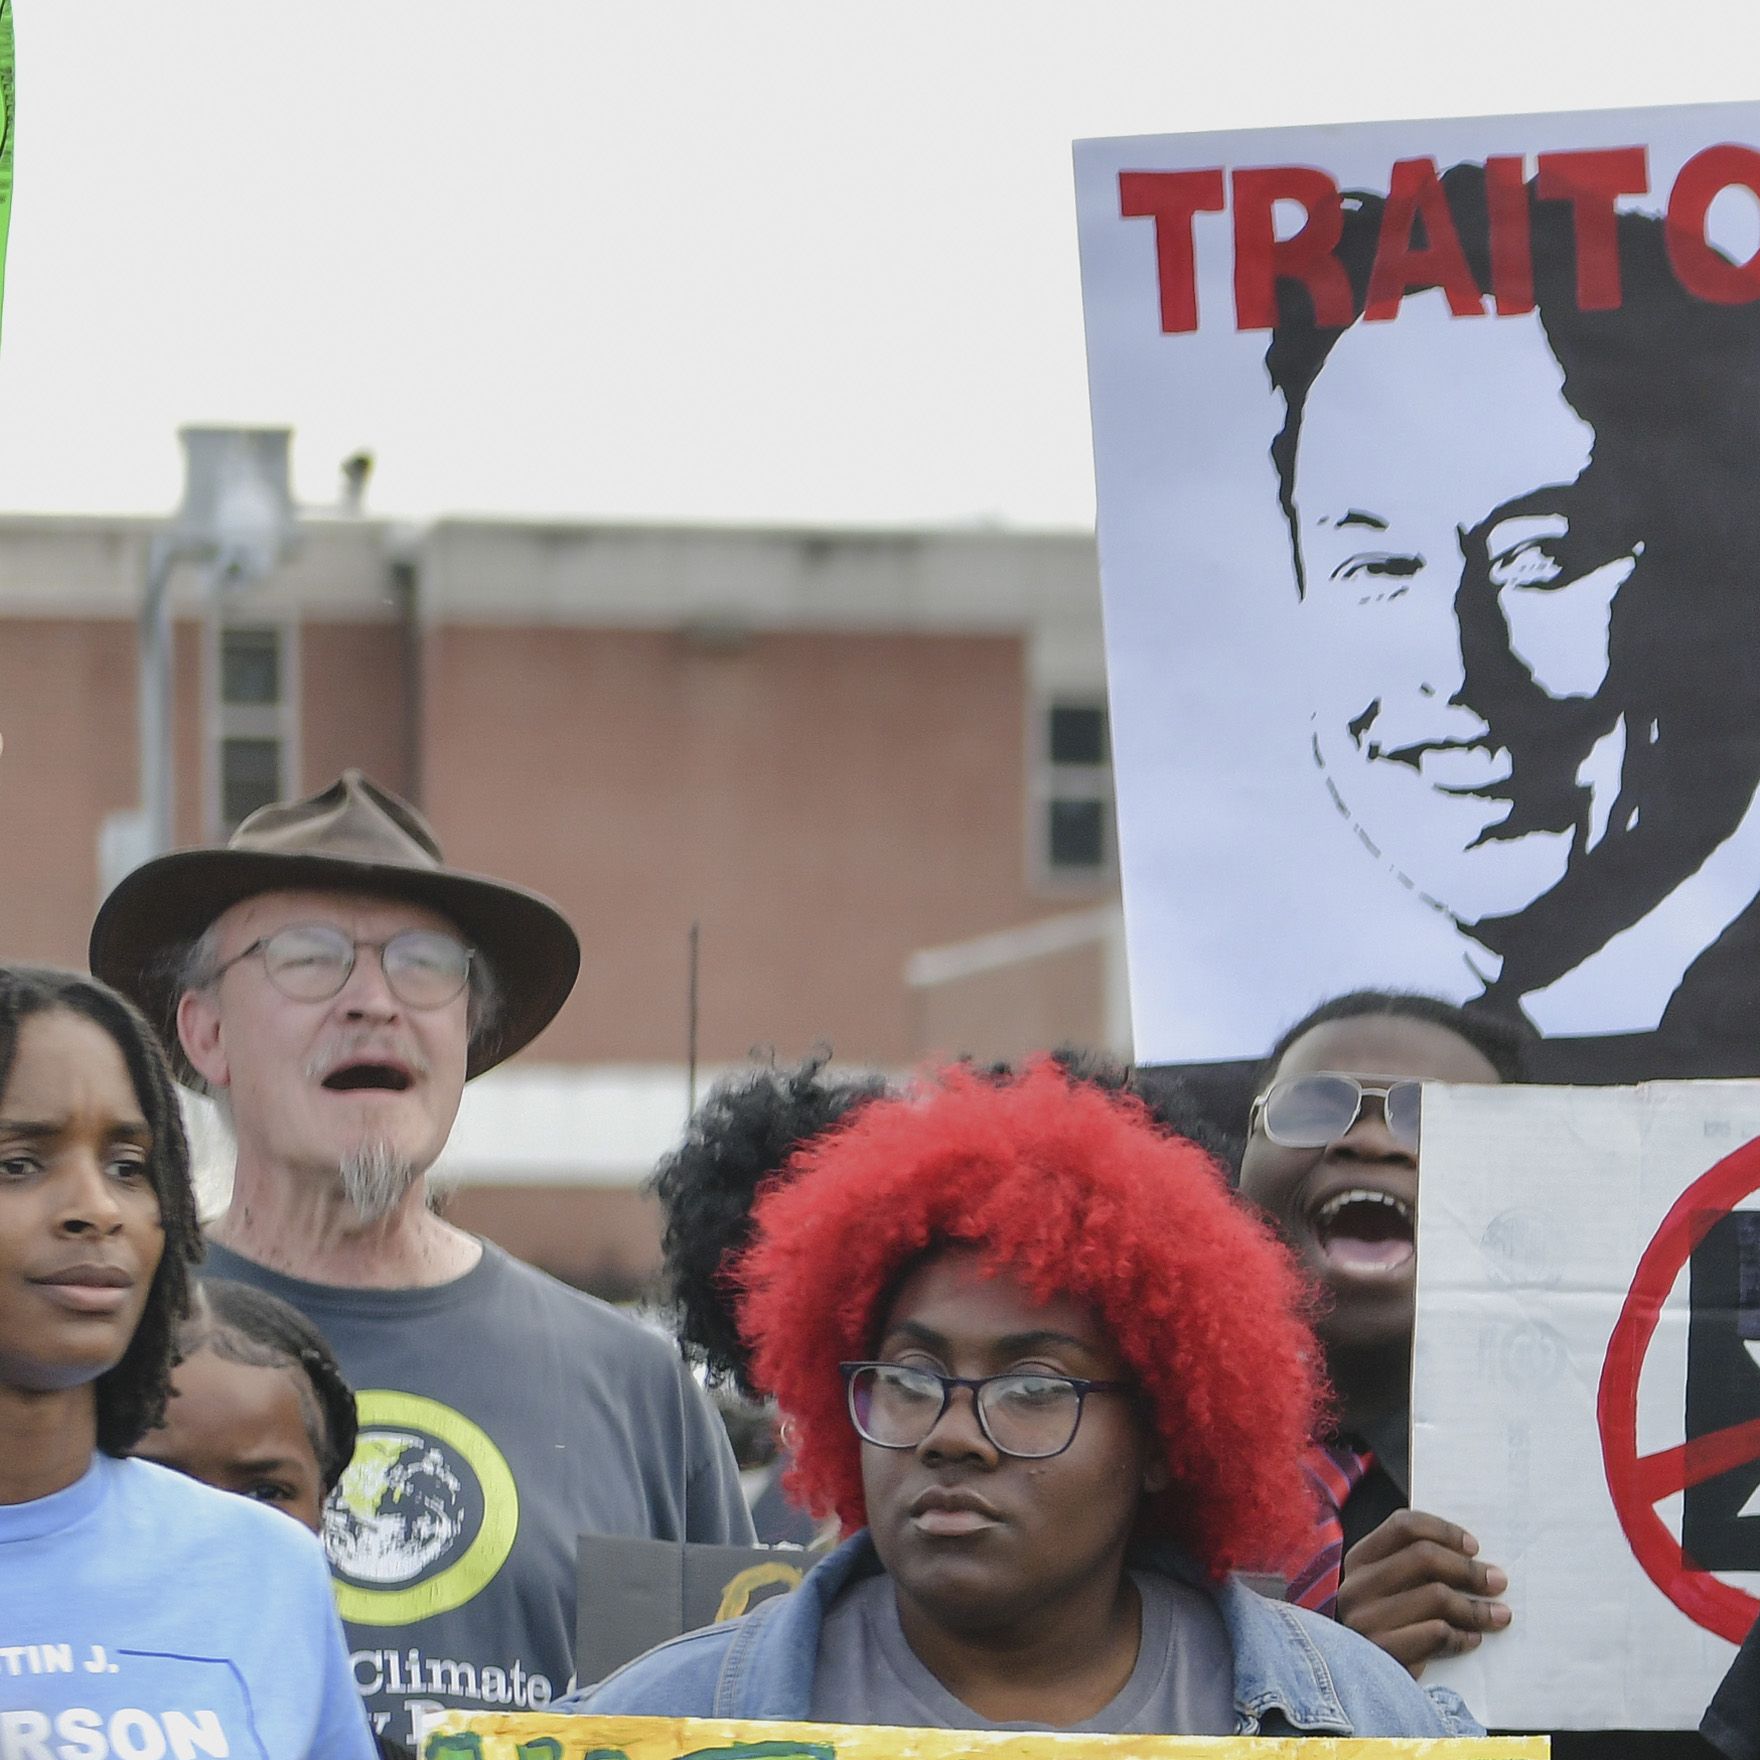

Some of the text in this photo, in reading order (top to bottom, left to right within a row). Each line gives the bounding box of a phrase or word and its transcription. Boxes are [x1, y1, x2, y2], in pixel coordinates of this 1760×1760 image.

[0, 1643, 120, 1676] TIN J.
[350, 1648, 552, 1710] Climate
